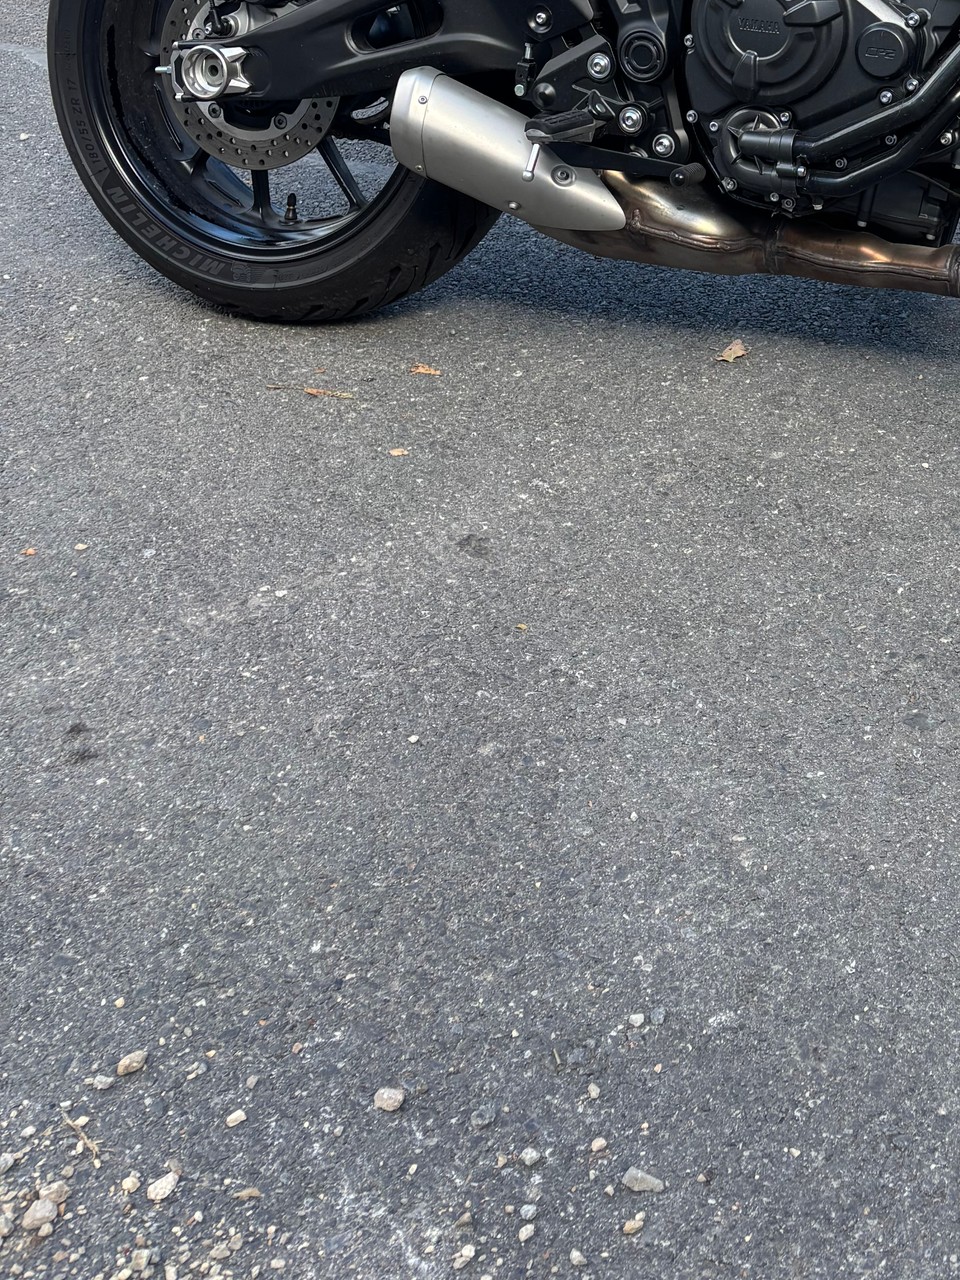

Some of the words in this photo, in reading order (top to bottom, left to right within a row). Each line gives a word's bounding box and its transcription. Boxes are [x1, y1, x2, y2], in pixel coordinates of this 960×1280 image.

[738, 16, 781, 35] YAMAHA
[71, 96, 84, 116] ZR
[78, 119, 103, 165] 180/55
[106, 186, 225, 275] MICHELIN
